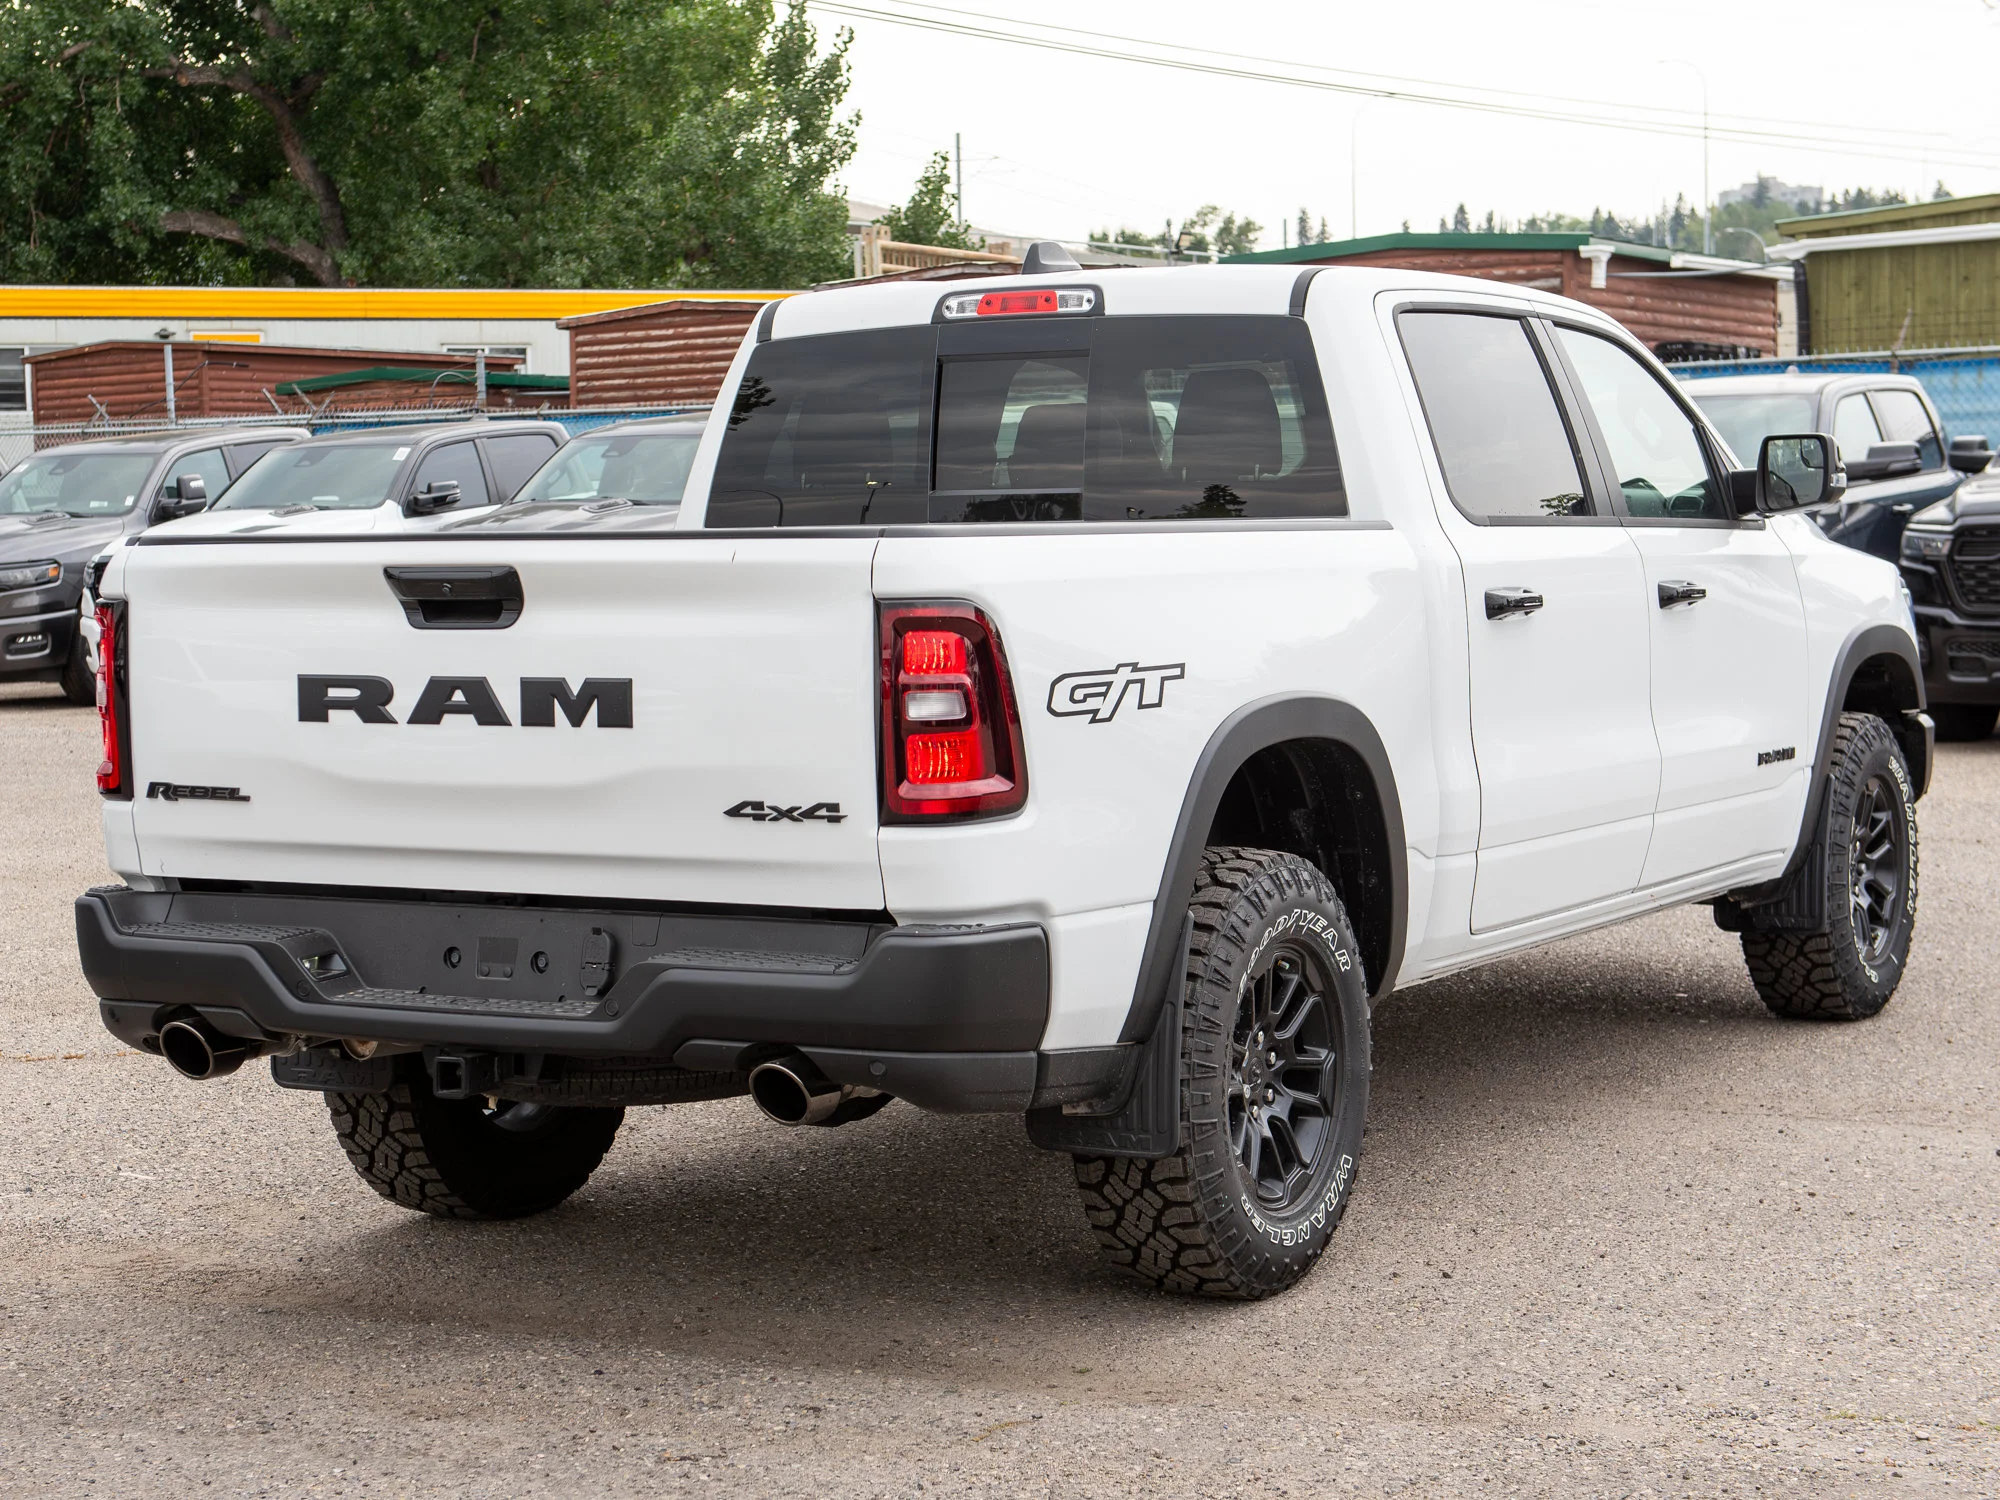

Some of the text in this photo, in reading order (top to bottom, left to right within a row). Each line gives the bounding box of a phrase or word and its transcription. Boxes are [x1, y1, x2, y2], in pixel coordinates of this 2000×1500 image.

[297, 673, 633, 729] RAM
[146, 781, 251, 802] REBEL
[1888, 755, 1916, 915] WRANGLER
[1237, 908, 1351, 1004] GOODYEAR
[1240, 1153, 1353, 1247] WRANGLER
